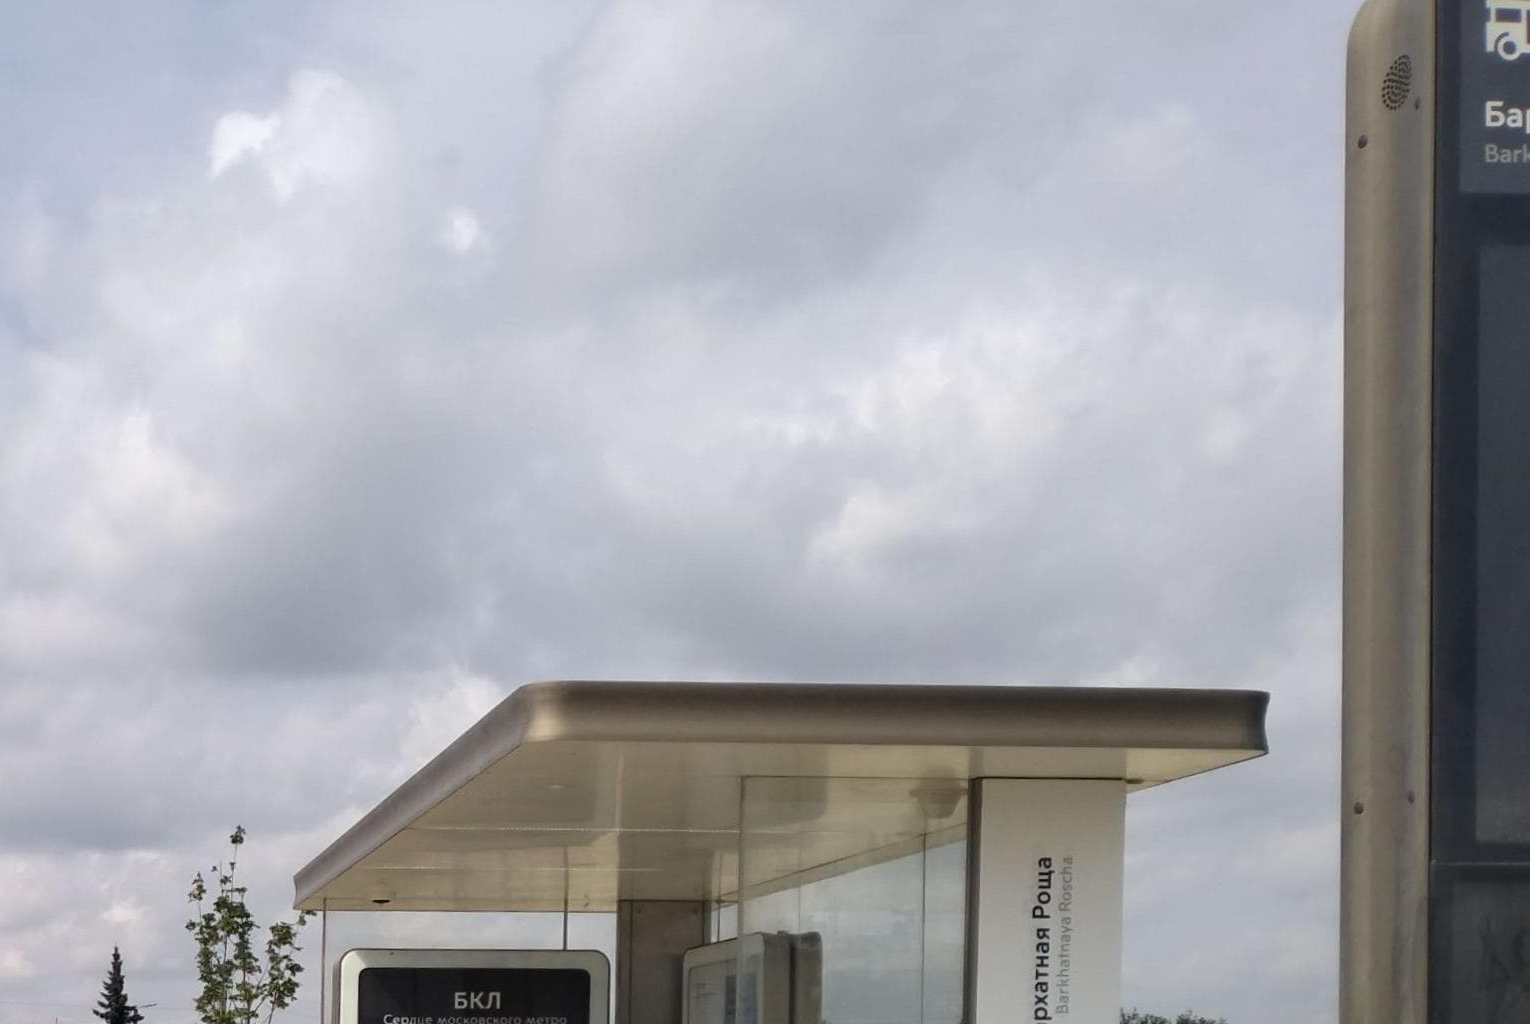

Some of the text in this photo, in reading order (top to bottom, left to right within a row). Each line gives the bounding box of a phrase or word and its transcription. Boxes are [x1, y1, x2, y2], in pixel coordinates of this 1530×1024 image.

[1485, 101, 1530, 134] Ба
[1033, 856, 1055, 919] Роща
[1056, 856, 1073, 1014] Barkhatnaya Roscha
[454, 991, 502, 1010] БКЛ
